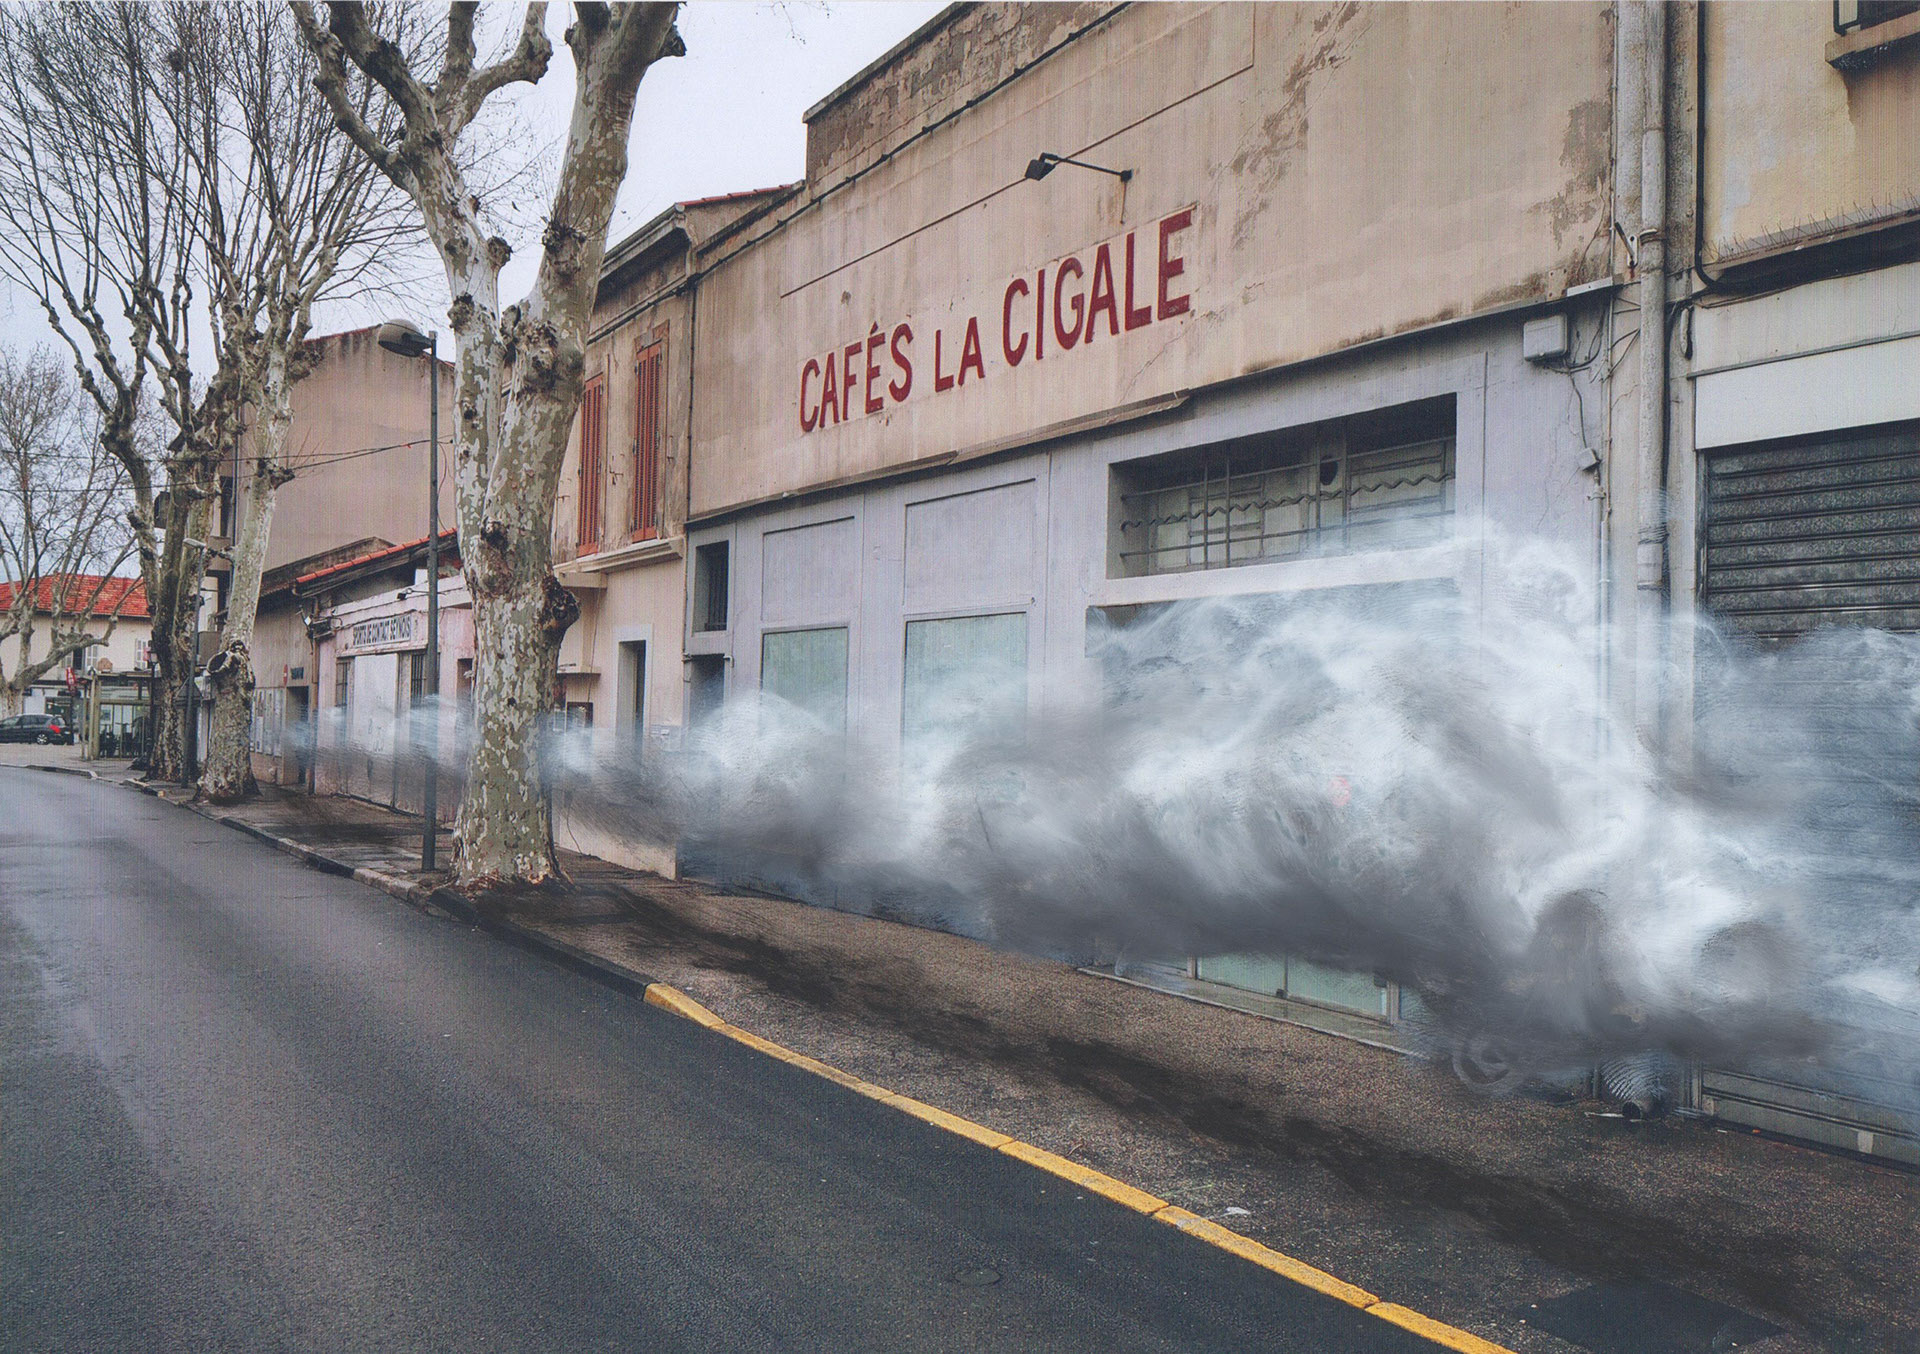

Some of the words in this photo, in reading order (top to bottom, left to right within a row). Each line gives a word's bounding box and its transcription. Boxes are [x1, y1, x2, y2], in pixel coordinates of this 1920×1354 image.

[799, 321, 913, 432] CAFÉS
[934, 317, 986, 393] LA
[1002, 208, 1194, 367] CIGALE
[353, 625, 366, 645] SPORTS
[372, 620, 390, 643] CONTACT
